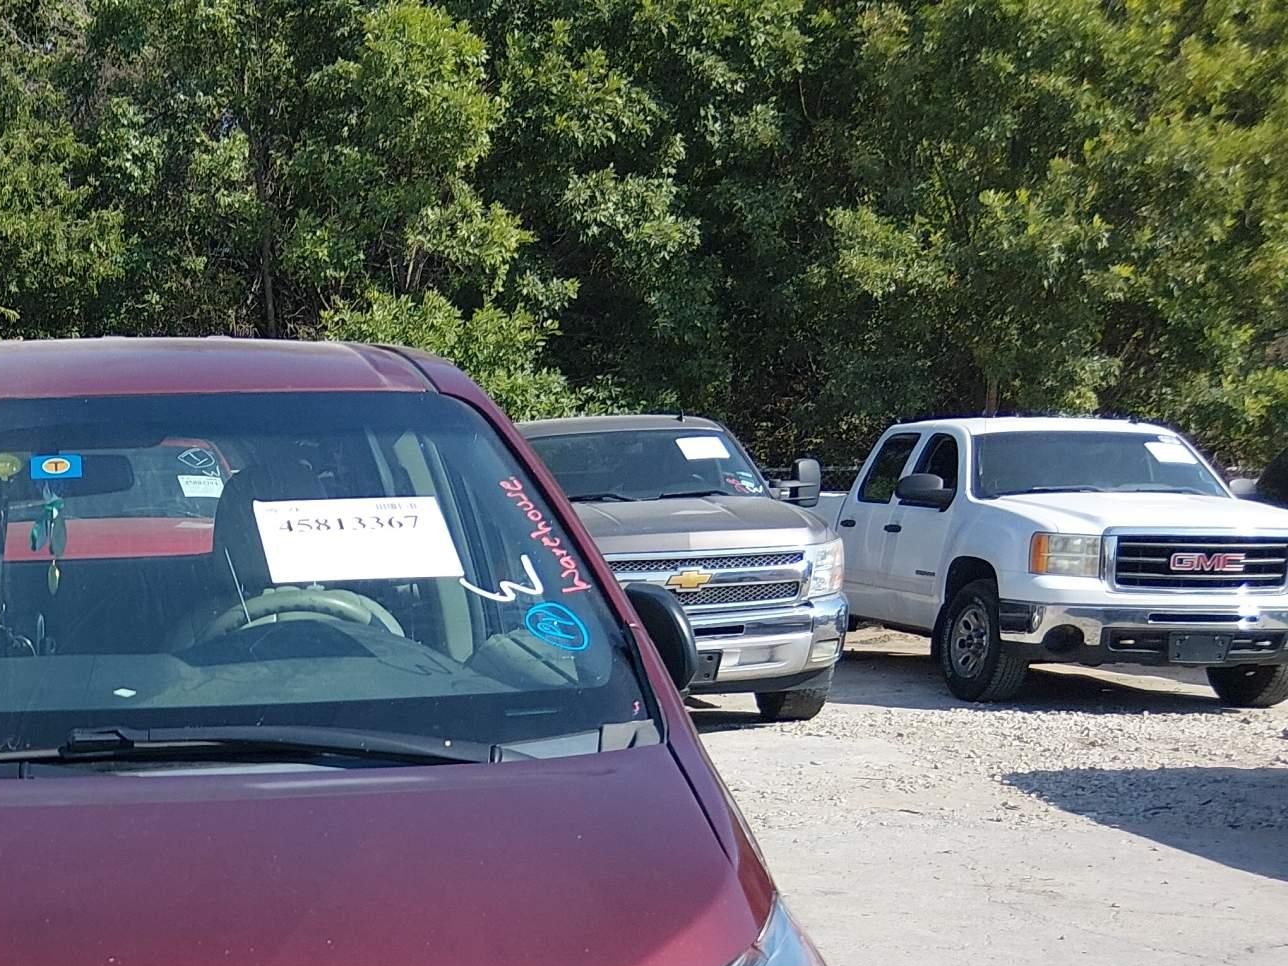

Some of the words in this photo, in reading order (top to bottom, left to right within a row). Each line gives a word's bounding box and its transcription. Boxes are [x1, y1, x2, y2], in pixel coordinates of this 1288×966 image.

[279, 515, 418, 533] 45813367
[499, 476, 593, 593] Warehouse
[1170, 553, 1246, 571] GMC
